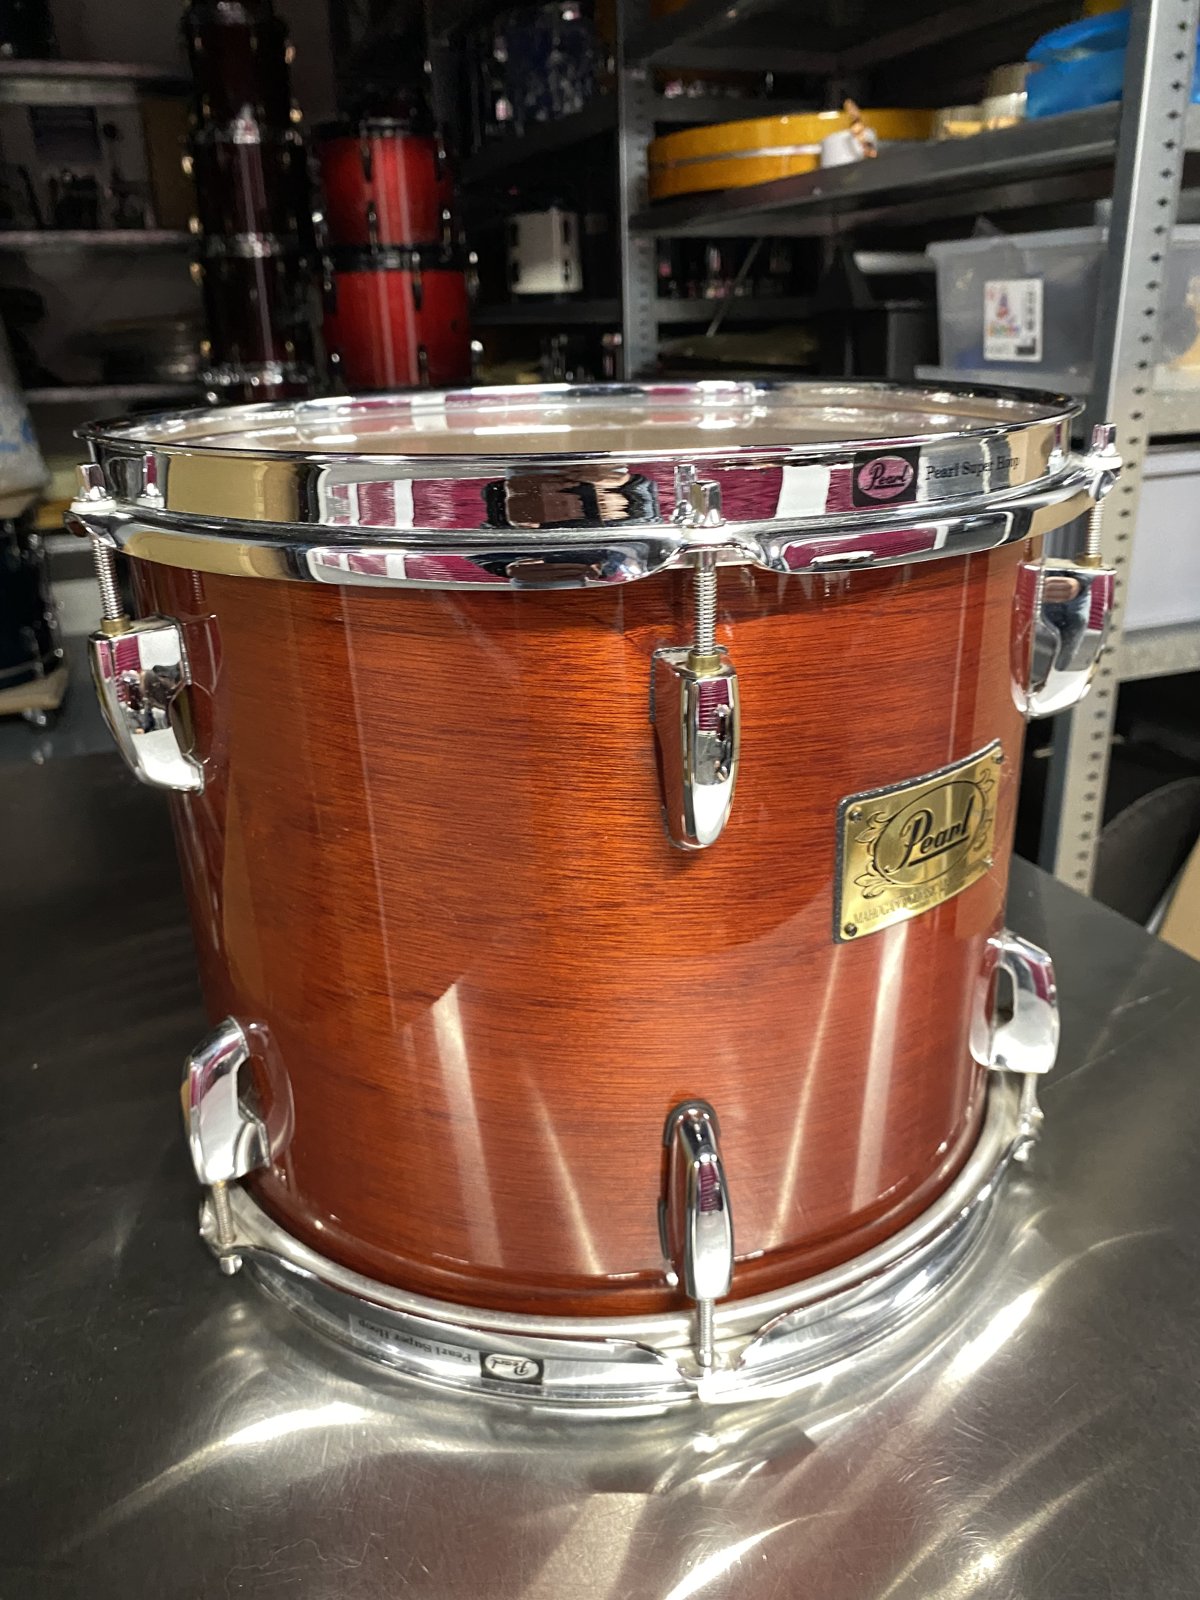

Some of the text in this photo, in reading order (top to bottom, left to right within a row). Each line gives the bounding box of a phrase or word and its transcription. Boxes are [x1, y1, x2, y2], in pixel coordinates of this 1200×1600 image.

[863, 461, 907, 491] Pearl
[925, 463, 960, 481] Pearl
[962, 460, 994, 477] Super
[884, 795, 977, 874] Pearl
[358, 1319, 472, 1363] Pearl Super Hoop
[490, 1356, 535, 1377] Pearl
